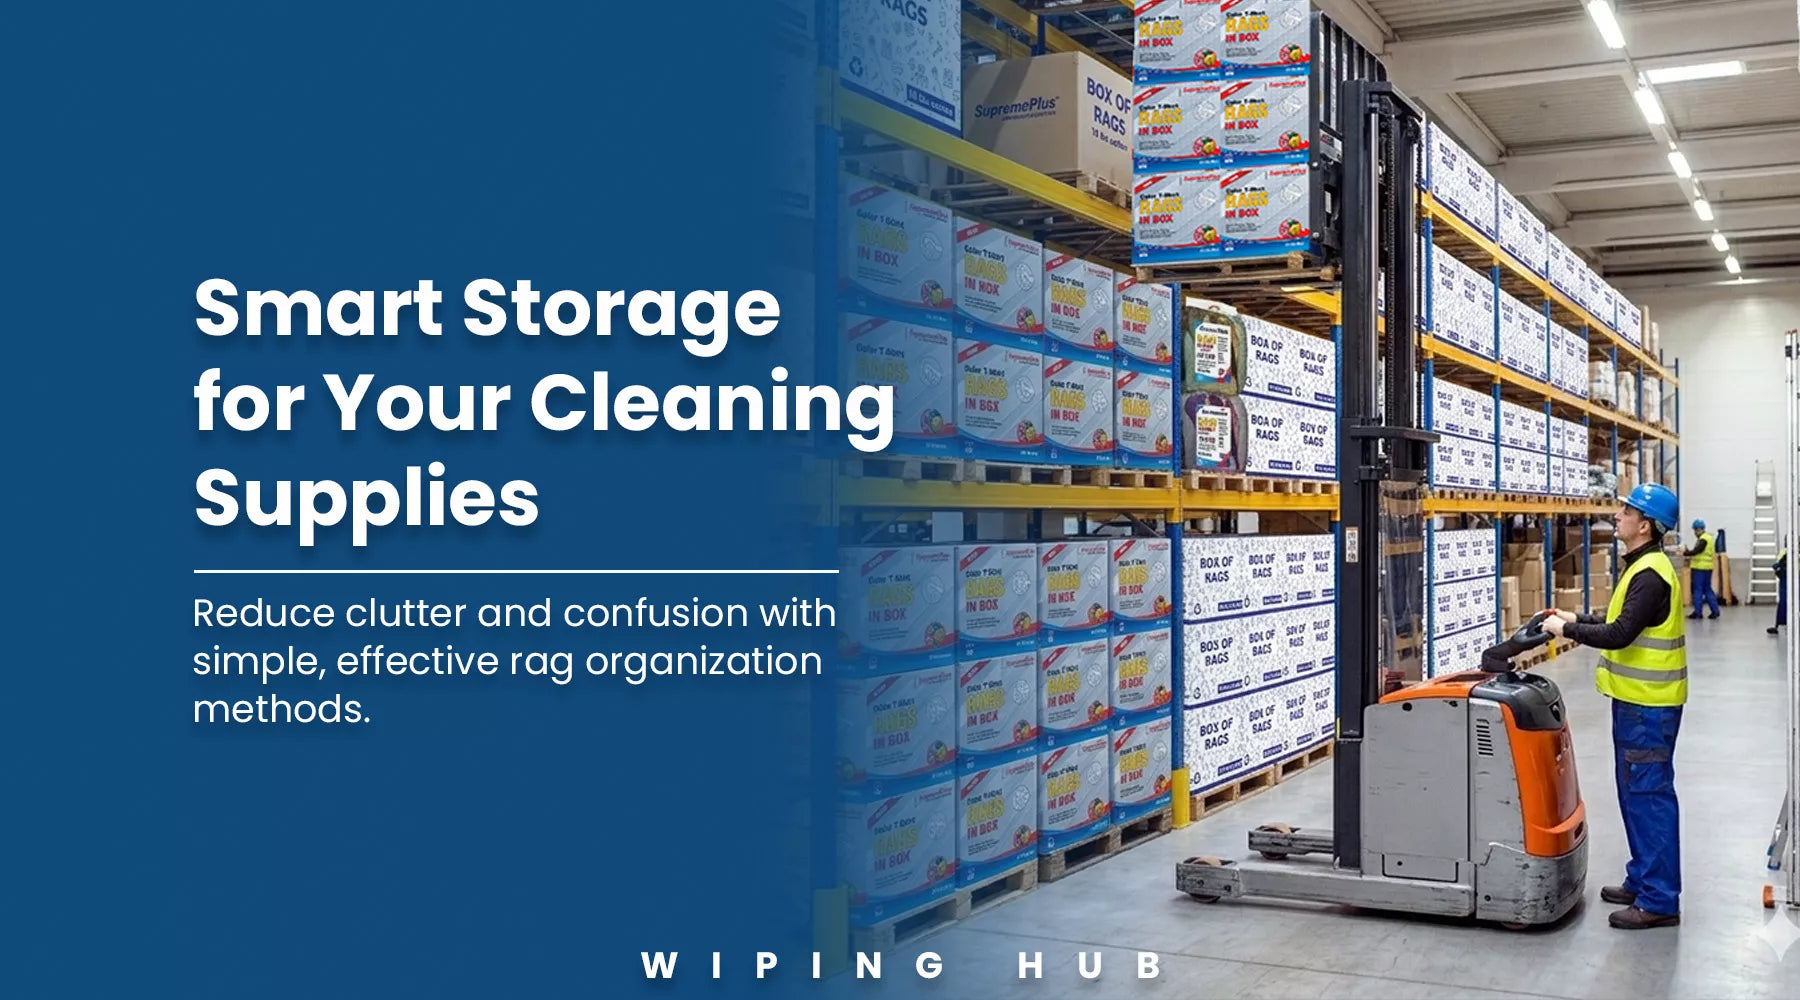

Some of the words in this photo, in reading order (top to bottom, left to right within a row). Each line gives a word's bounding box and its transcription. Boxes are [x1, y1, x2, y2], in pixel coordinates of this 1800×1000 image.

[1139, 20, 1184, 37] RAGS
[1226, 16, 1269, 33] RAGS
[1152, 38, 1173, 47] BOX
[1239, 32, 1260, 42] BOX
[1086, 77, 1113, 106] BOX
[1115, 93, 1132, 115] OF
[974, 96, 1058, 119] SupremePlus
[1225, 103, 1269, 120] RAGS
[1093, 105, 1126, 136] RAGS
[1138, 108, 1183, 126] RAGS
[1152, 126, 1173, 135] BOX
[1238, 120, 1258, 130] BOX
[1140, 197, 1183, 215] RAGS
[1225, 191, 1269, 209] RAGS
[1152, 214, 1173, 224] BOX
[1238, 208, 1259, 218] BOX
[1255, 350, 1279, 365] RAGS
[1255, 429, 1279, 442] RAGS
[1200, 557, 1220, 569] BOX
[1222, 556, 1234, 568] OF
[1221, 717, 1233, 731] OF
